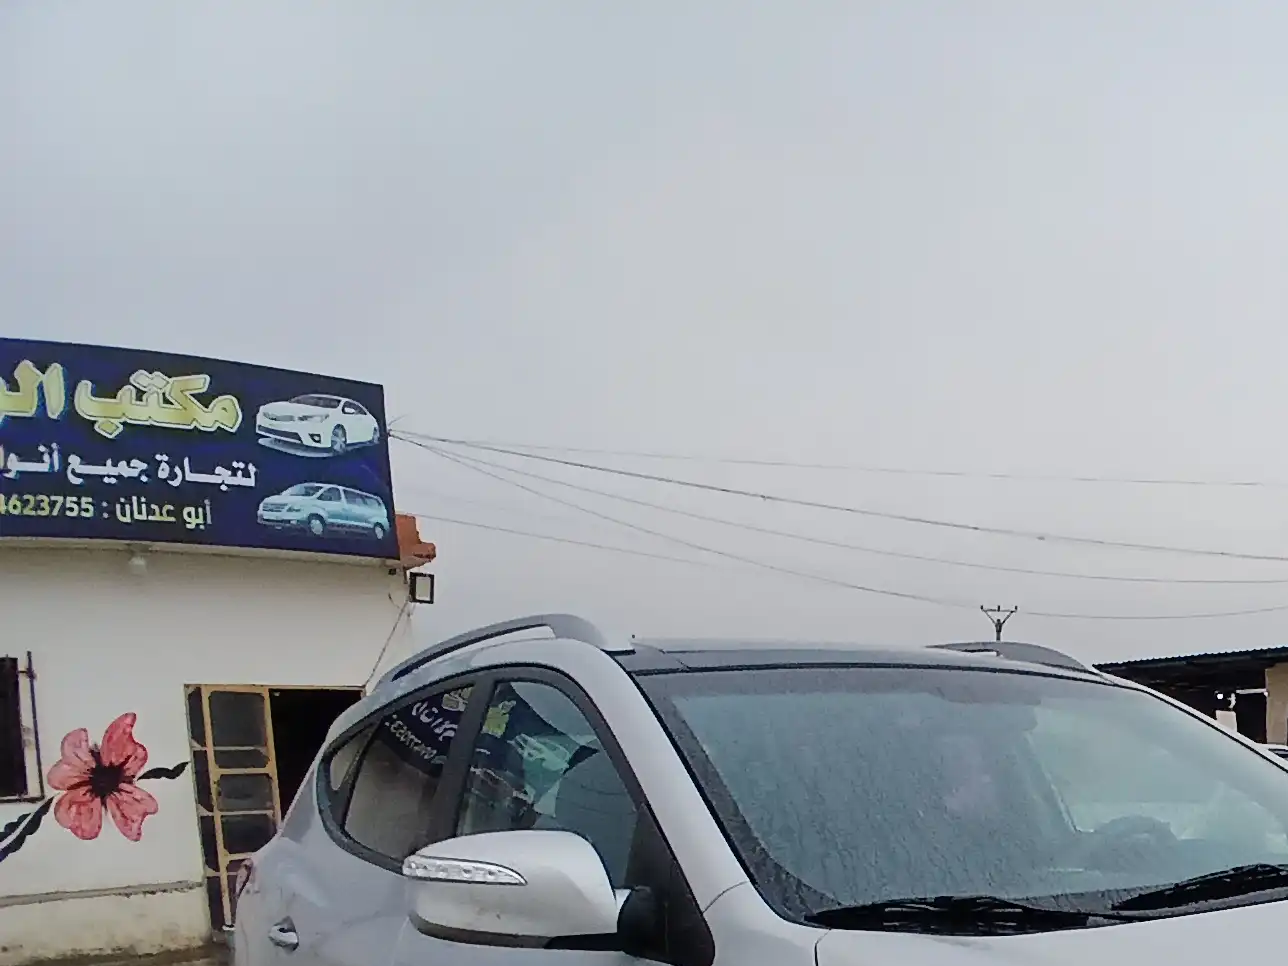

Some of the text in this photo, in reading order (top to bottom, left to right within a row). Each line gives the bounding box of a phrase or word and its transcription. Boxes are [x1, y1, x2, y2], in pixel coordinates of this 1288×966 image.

[0, 359, 242, 439] مكتب ال
[67, 454, 148, 484] جميع
[155, 453, 256, 491] لتجارة
[115, 495, 176, 524] عدنان
[182, 499, 212, 530] أبو
